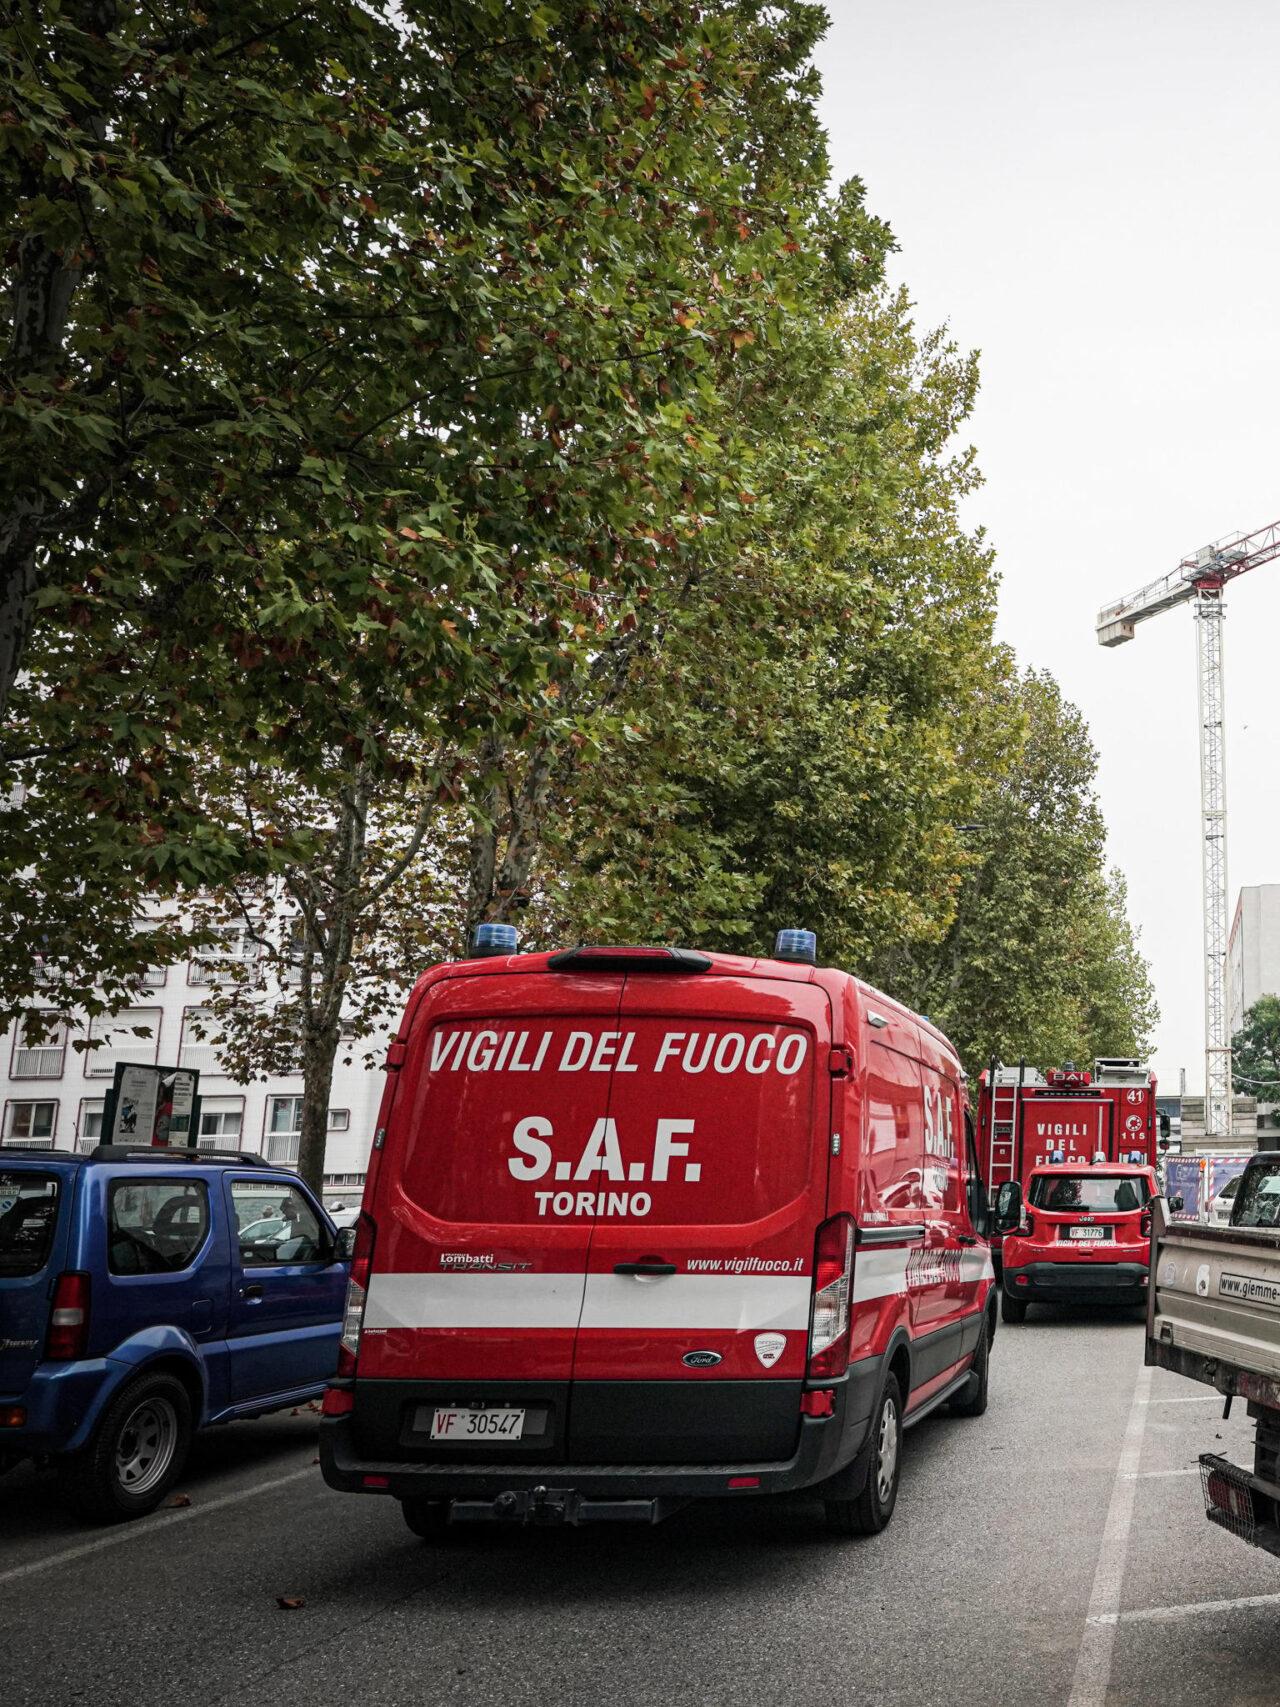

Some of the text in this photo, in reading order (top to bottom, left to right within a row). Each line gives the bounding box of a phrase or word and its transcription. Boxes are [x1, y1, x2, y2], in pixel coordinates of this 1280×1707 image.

[429, 1031, 808, 1075] VIGILI DEL FUOCO
[1053, 1072, 1084, 1081] BAI
[1127, 1090, 1143, 1103] 41
[1037, 1123, 1088, 1136] VIGILI
[1121, 1132, 1146, 1140] 115
[508, 1116, 702, 1182] S.A.F.
[1046, 1139, 1076, 1151] DEL
[1035, 1155, 1087, 1167] FCO
[534, 1192, 652, 1217] TORINO
[440, 1253, 494, 1263] Lombatti
[687, 1256, 804, 1274] www.vigilfuoco.it
[690, 1354, 713, 1364] Ford
[437, 1413, 520, 1434] VF 30547
